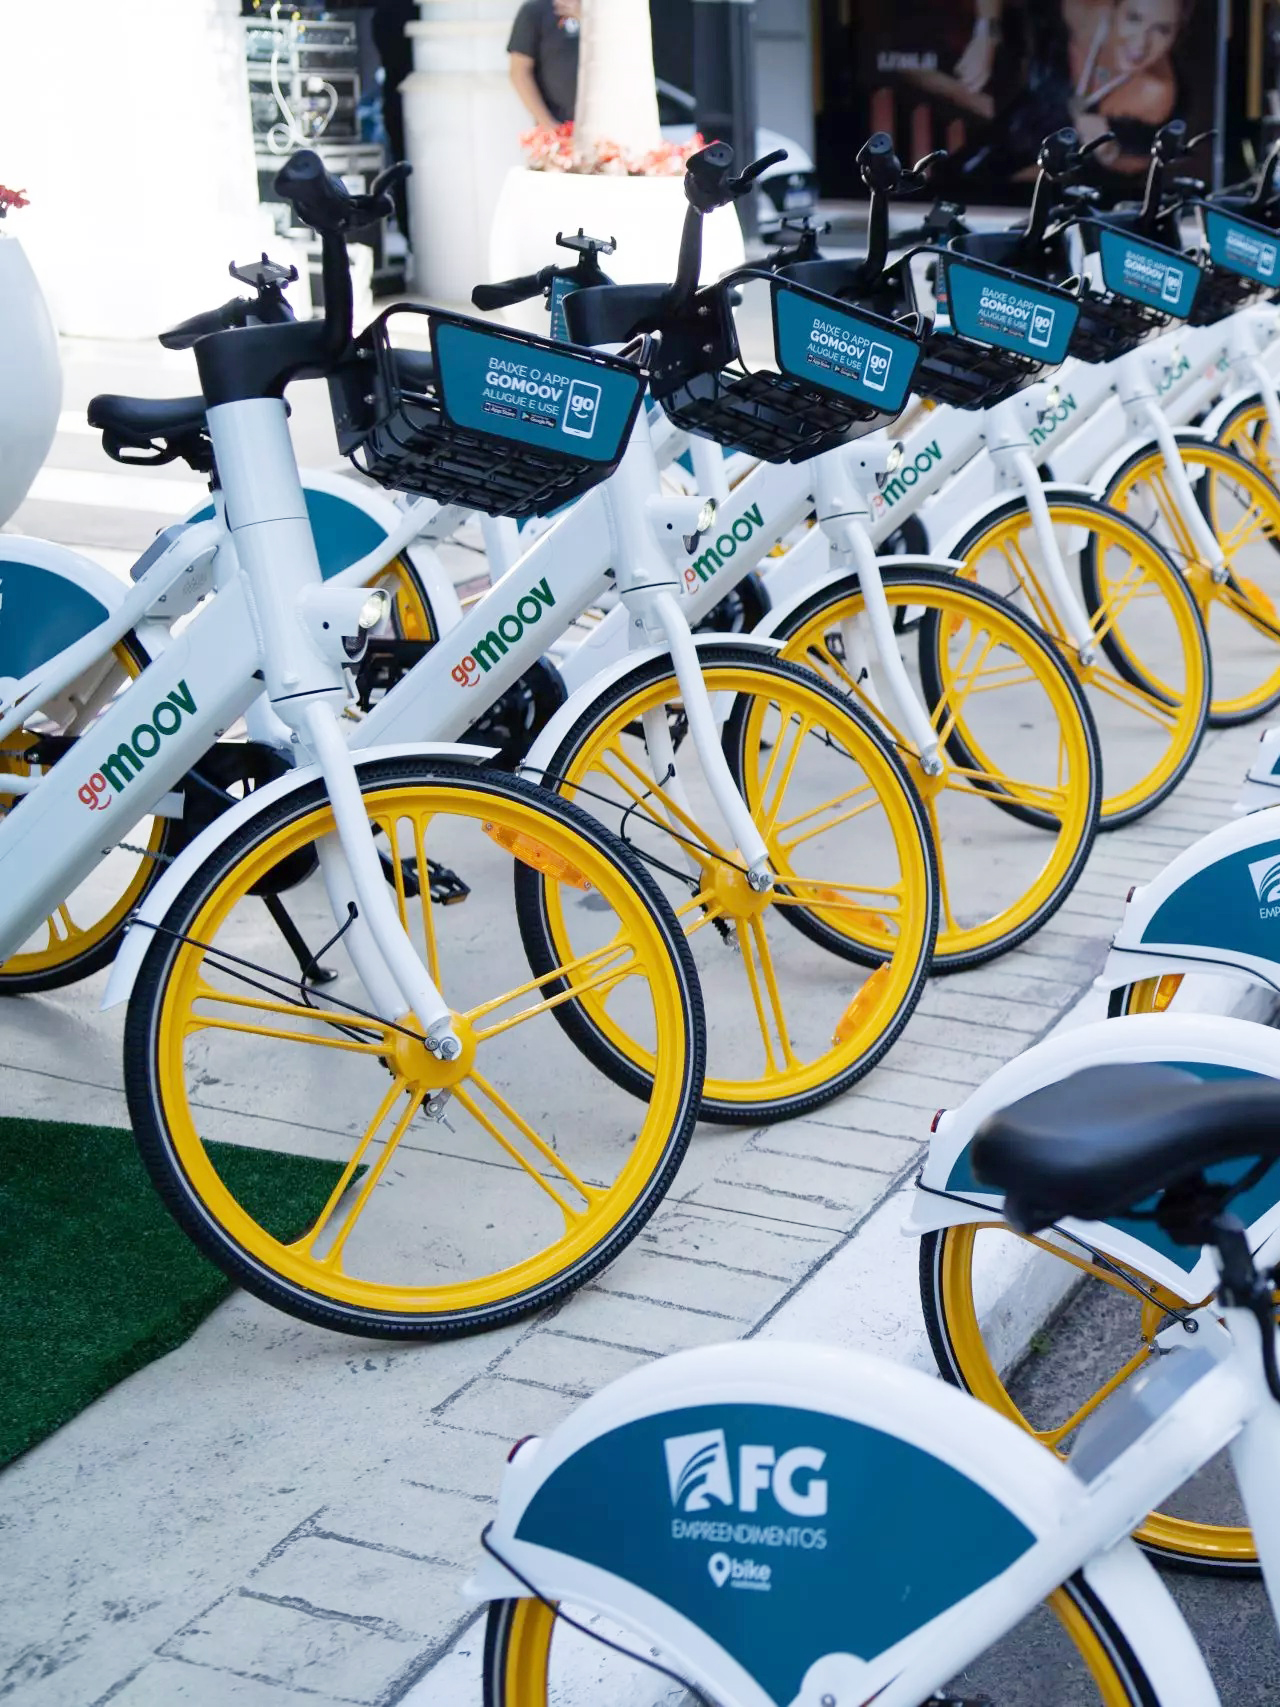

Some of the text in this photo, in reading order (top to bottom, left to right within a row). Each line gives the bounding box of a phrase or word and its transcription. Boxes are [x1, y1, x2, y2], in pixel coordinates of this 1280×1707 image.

[980, 297, 1030, 320] GOMOOV
[982, 287, 1035, 310] BAIXE O APP
[813, 318, 871, 347] BAIXE O APP
[1034, 315, 1050, 328] go
[807, 343, 839, 361] ALUGUE
[839, 355, 846, 364] E
[846, 358, 862, 370] USE
[810, 330, 865, 359] GOMOOV
[488, 357, 570, 387] BAIXE O APP
[869, 355, 887, 369] go
[485, 371, 563, 402] GOMOOV
[482, 388, 559, 416] ALUGUE E USE
[571, 395, 595, 412] go
[873, 440, 942, 507] omoov
[684, 503, 764, 583] omoov
[451, 577, 556, 687] gomoov
[78, 679, 199, 811] gomoov
[739, 1444, 828, 1517] FG
[672, 1518, 828, 1549] EMPREENDIMENTOS
[731, 1558, 772, 1581] bike
